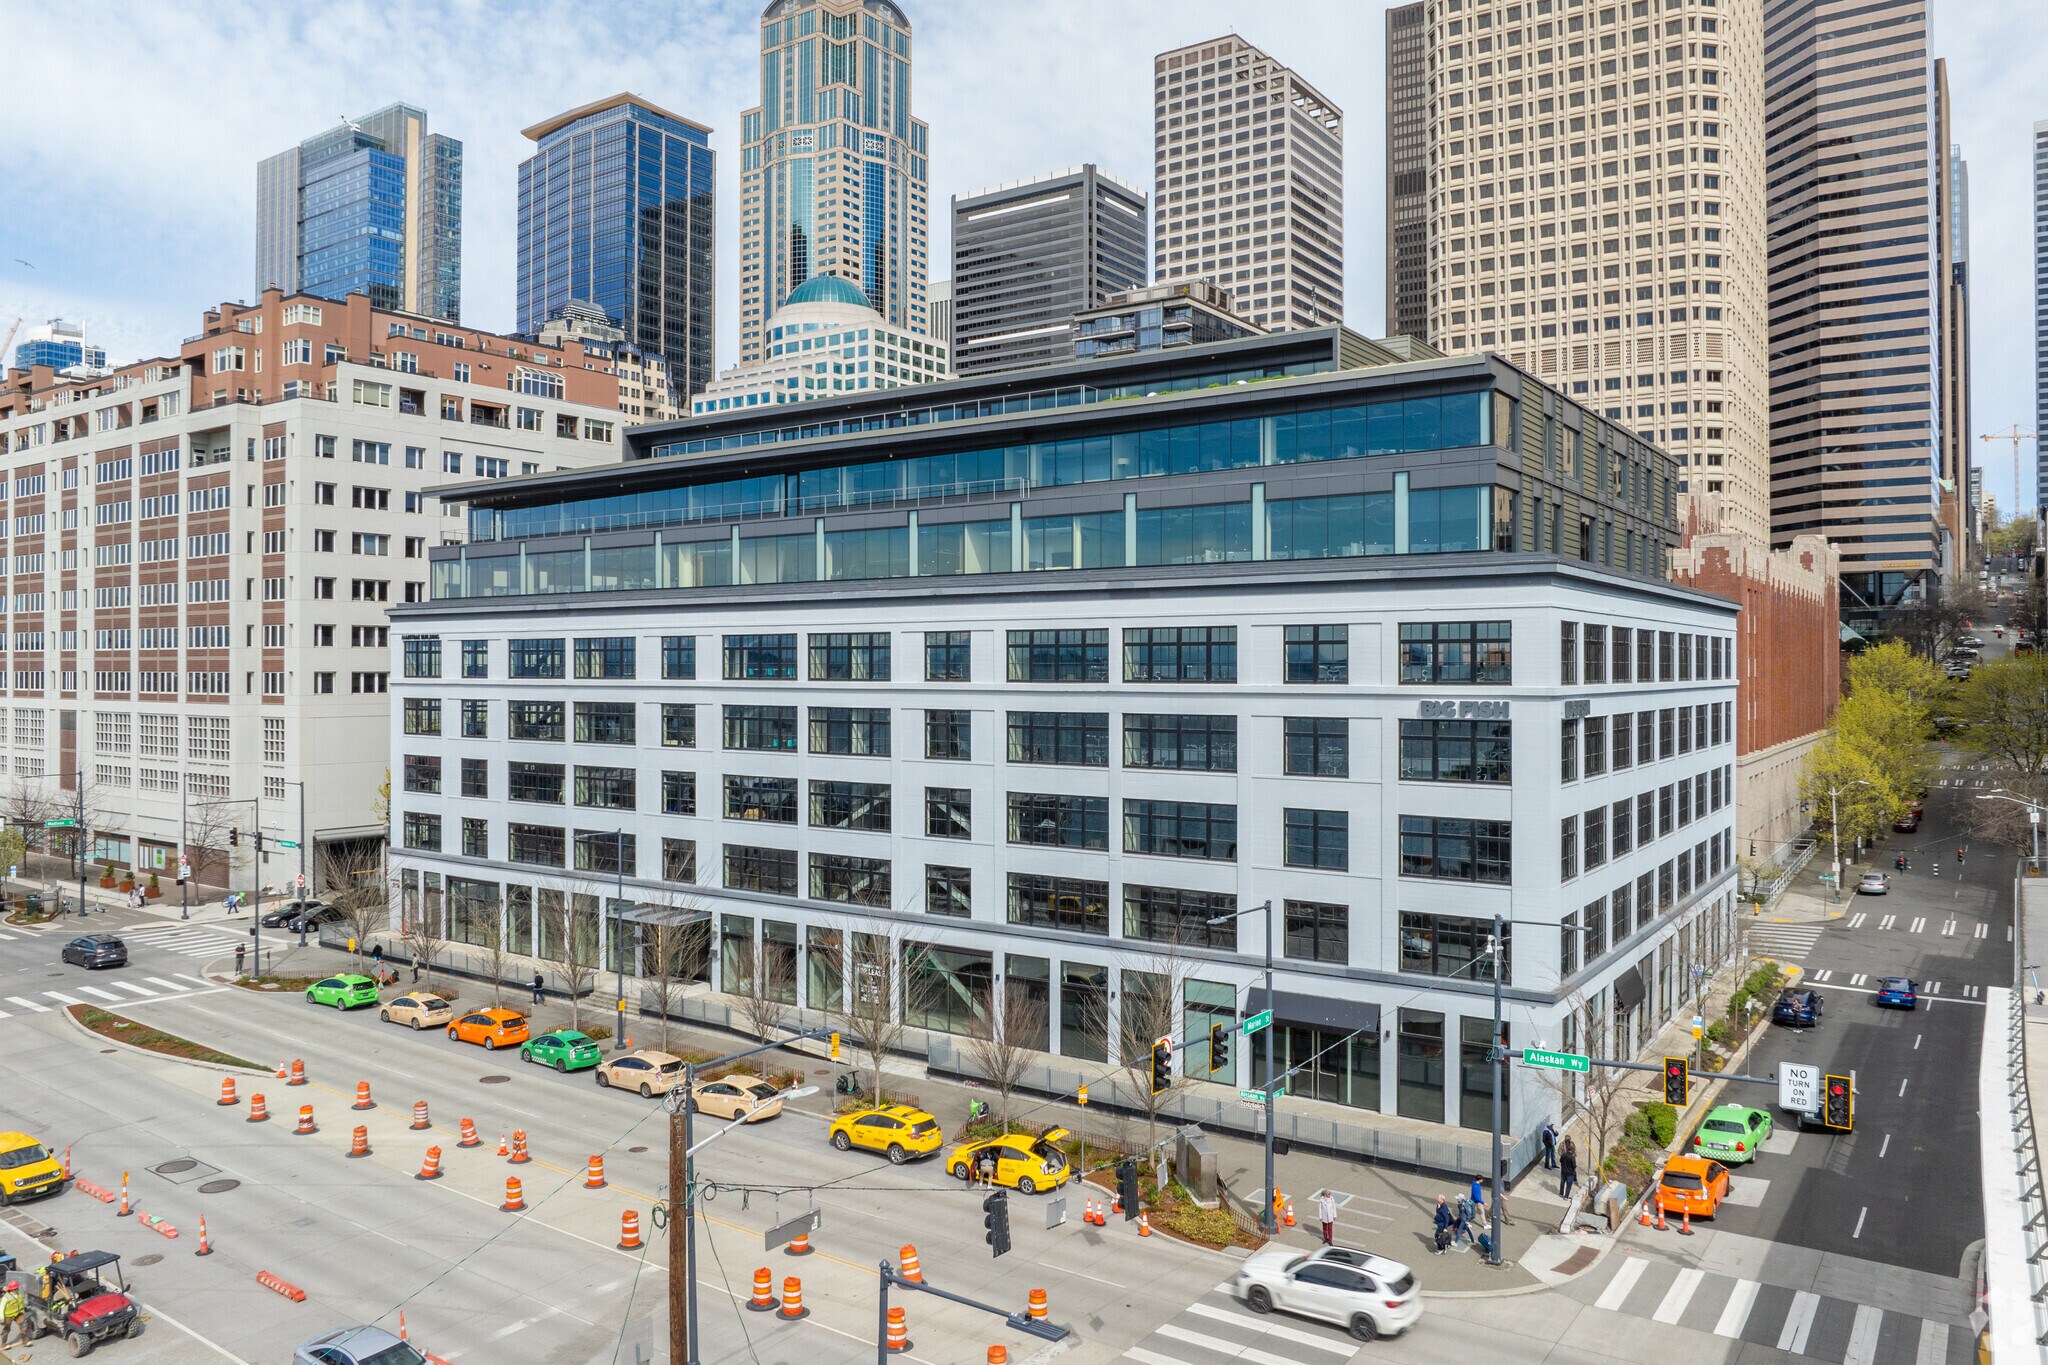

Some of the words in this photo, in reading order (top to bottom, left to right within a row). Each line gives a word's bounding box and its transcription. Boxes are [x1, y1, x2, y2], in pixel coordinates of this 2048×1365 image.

[1420, 700, 1456, 718] BIG
[1459, 700, 1510, 718] FISH
[1529, 1052, 1565, 1065] Alaskan
[1571, 1059, 1583, 1069] Wy
[1790, 1069, 1808, 1079] NO
[1788, 1079, 1810, 1088] TURN
[1793, 1088, 1805, 1096] ON
[1790, 1097, 1807, 1105] RED
